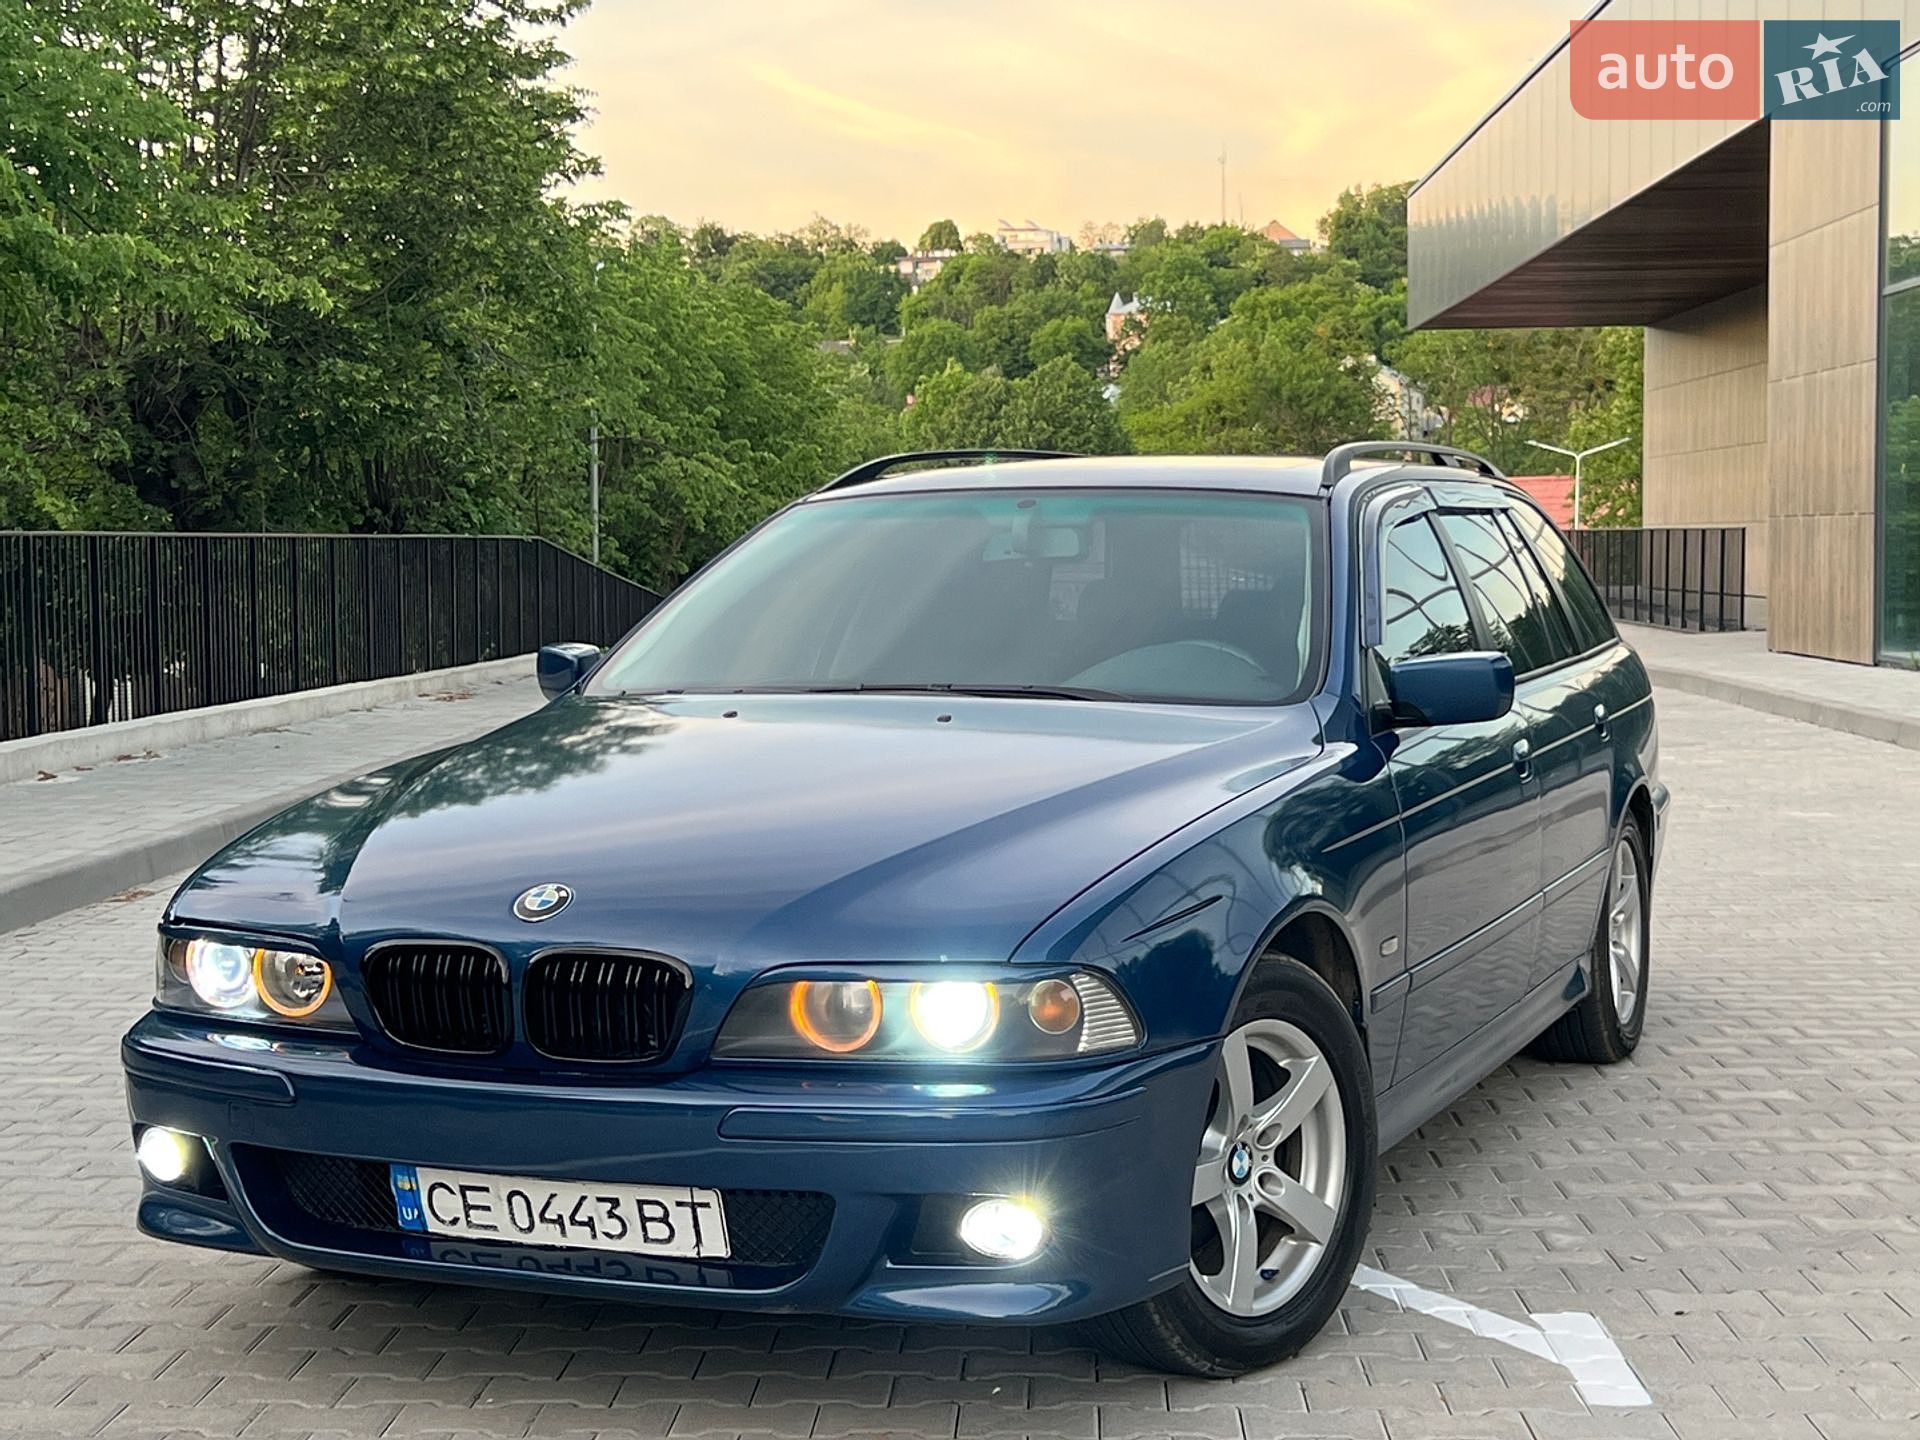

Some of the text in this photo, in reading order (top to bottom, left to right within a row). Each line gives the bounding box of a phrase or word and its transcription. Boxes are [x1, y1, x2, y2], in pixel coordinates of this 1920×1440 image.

[427, 1182, 711, 1251] CE 0443 BT
